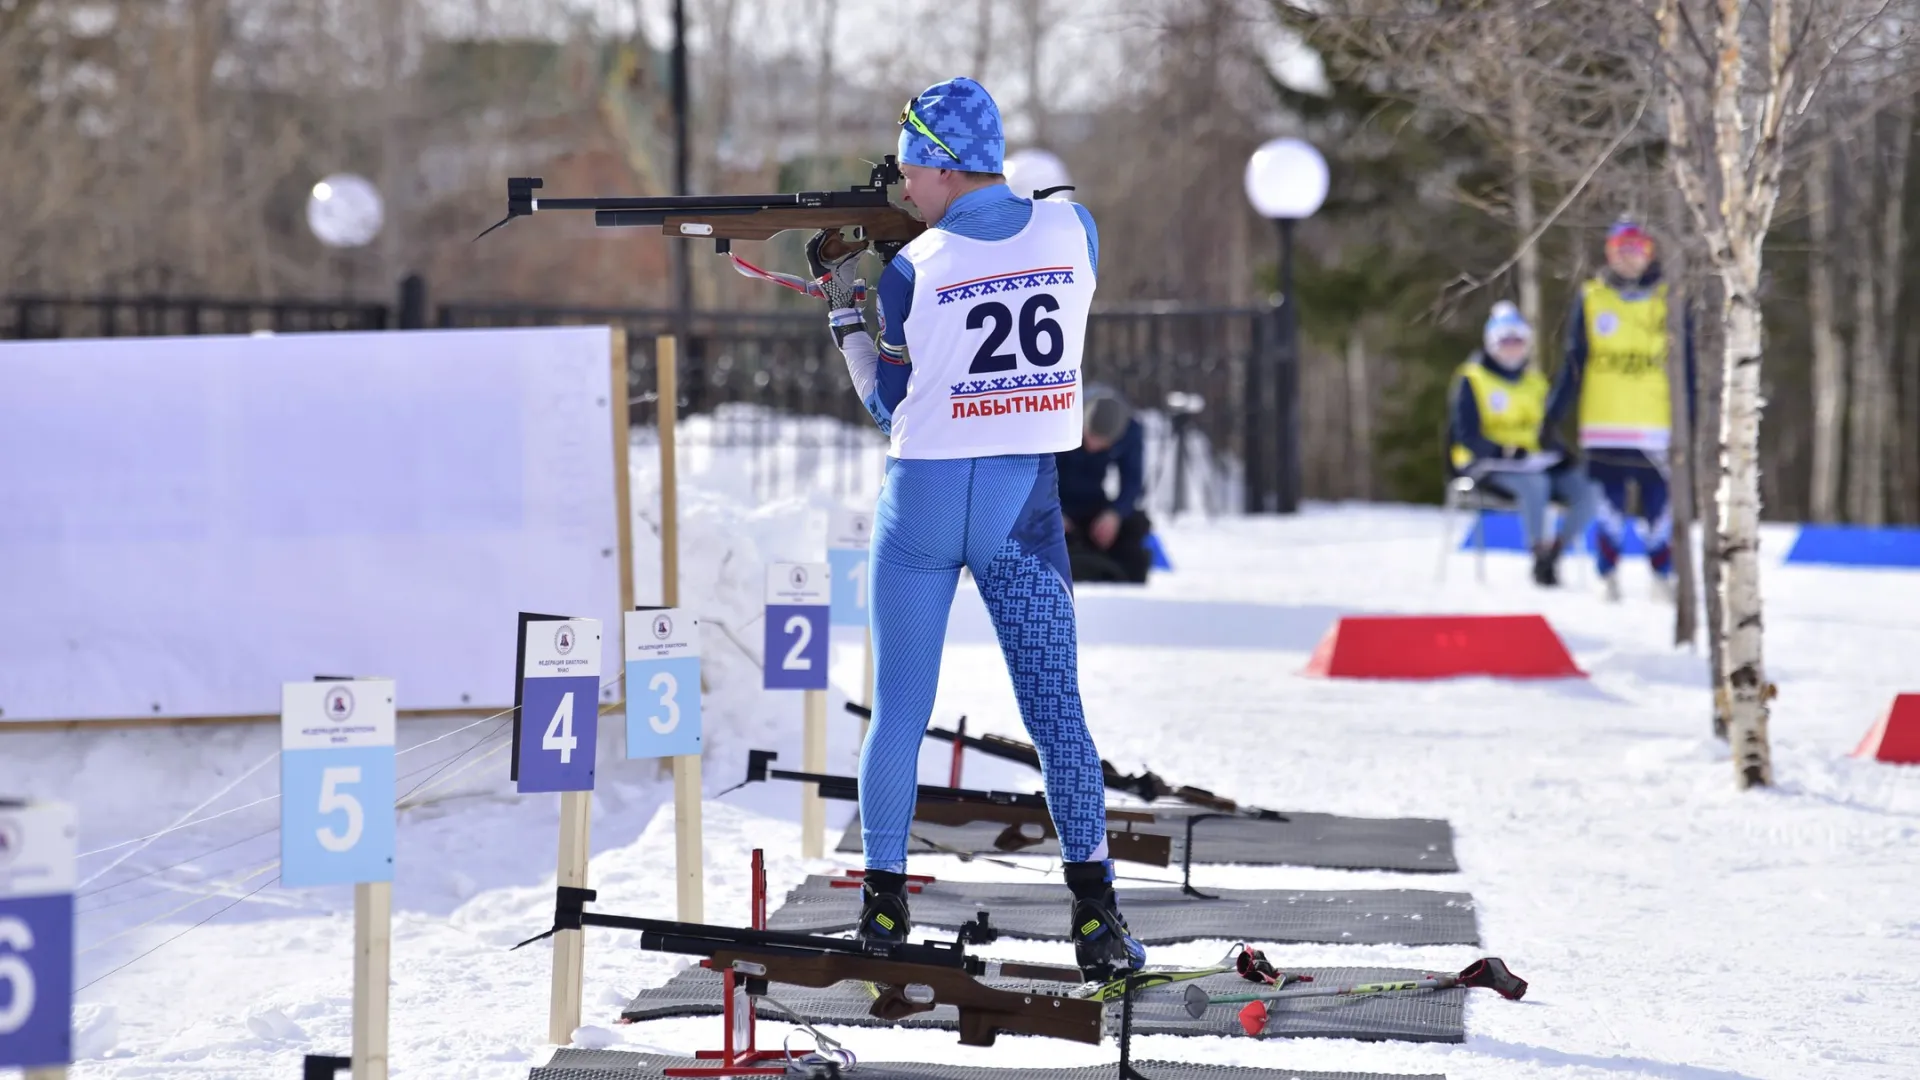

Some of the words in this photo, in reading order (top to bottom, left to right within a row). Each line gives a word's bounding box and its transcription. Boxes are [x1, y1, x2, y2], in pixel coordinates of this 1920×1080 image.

[966, 294, 1063, 374] 26
[847, 559, 868, 609] 1
[782, 615, 812, 670] 2
[543, 691, 577, 763] 4
[648, 672, 680, 734] 3
[316, 766, 364, 852] 5
[0, 917, 34, 1031] 6
